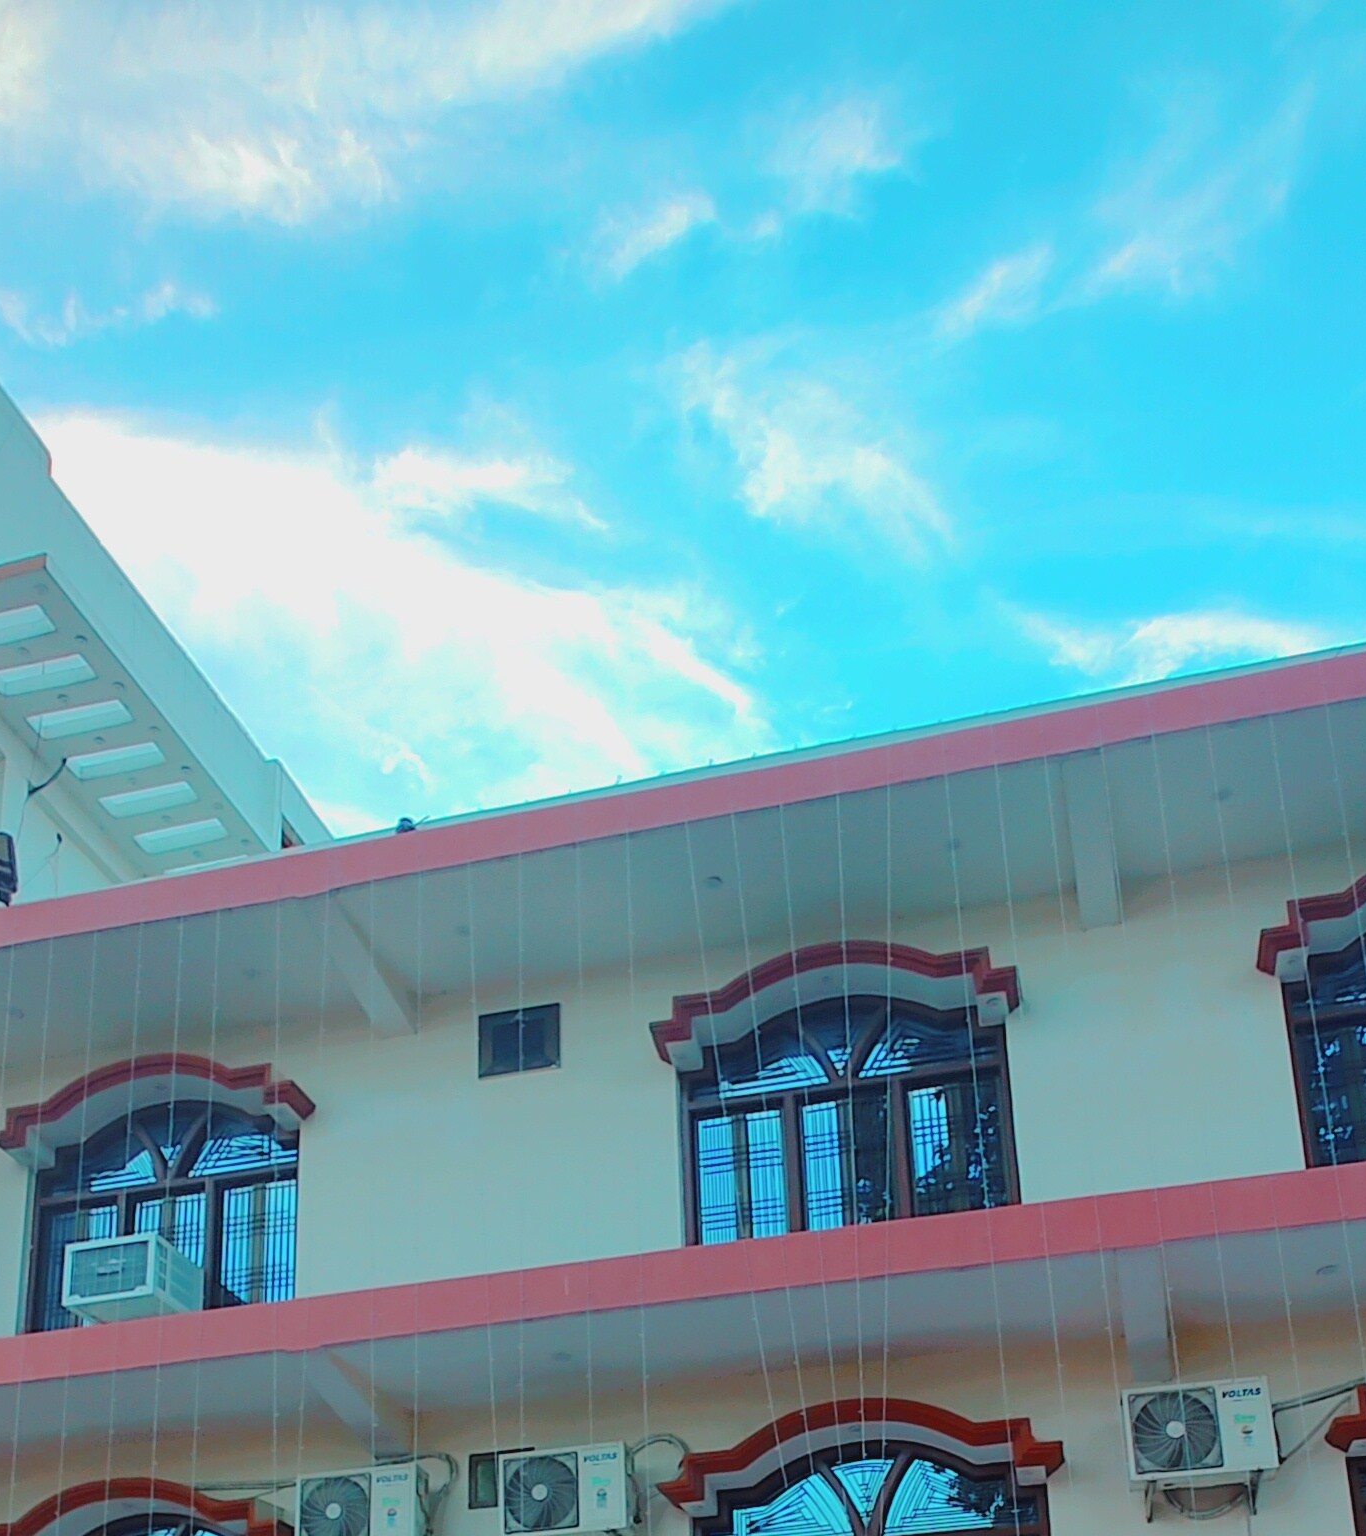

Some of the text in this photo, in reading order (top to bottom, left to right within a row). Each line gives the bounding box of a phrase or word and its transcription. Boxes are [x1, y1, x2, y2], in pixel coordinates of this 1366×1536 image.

[1222, 1387, 1261, 1398] VOLTAS
[583, 1453, 618, 1463] VOLTAS
[376, 1473, 408, 1484] VOLTAS
